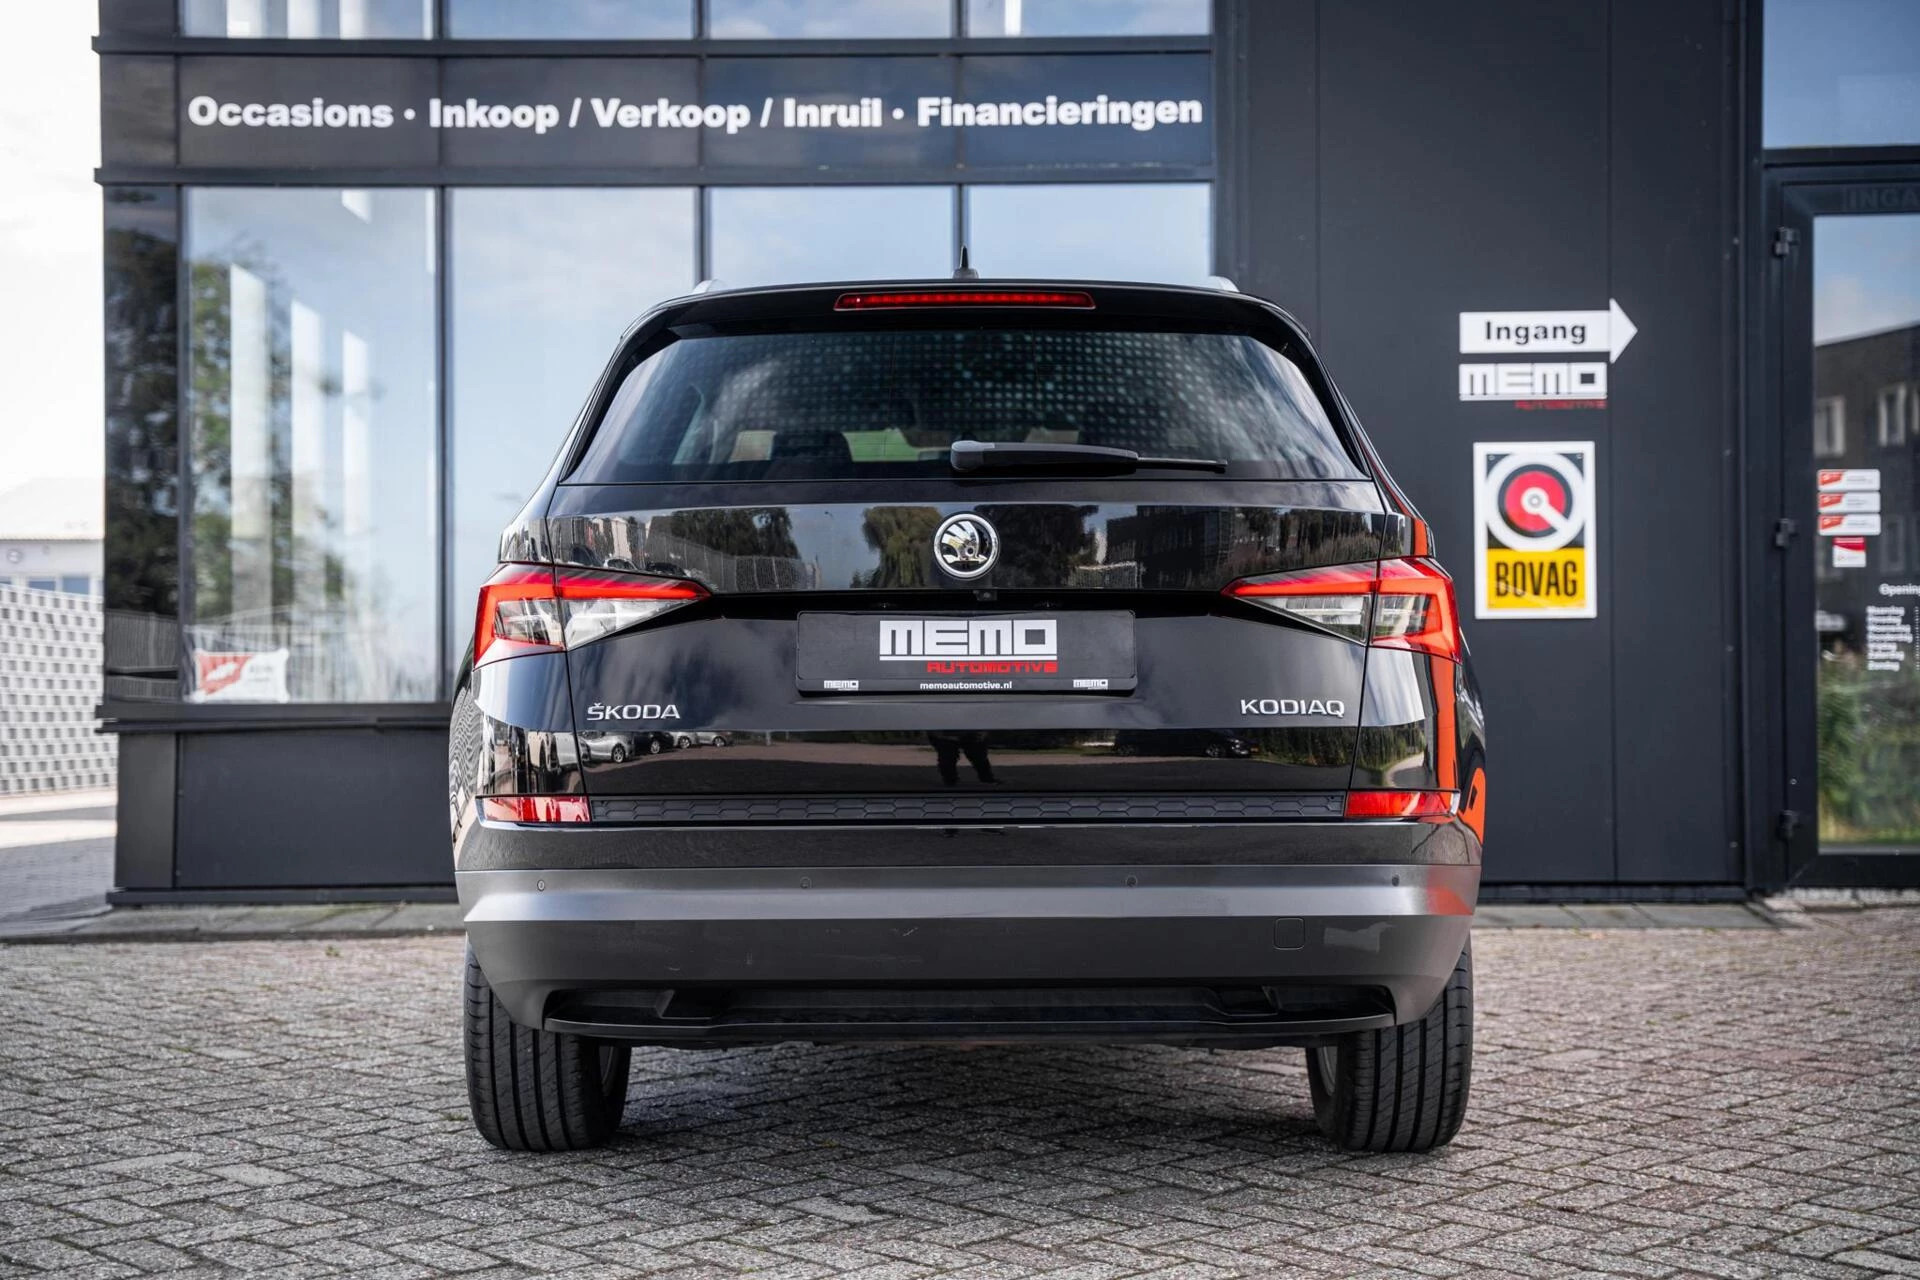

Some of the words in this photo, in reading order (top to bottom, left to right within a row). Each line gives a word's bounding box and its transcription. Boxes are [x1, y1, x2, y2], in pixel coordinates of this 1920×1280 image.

[188, 96, 394, 127] Occasions
[429, 98, 559, 134] Inkoop
[590, 98, 751, 134] Verkoop
[783, 97, 882, 127] Inruil
[917, 95, 1203, 131] Financieringen
[1486, 321, 1587, 344] Ingang
[1459, 362, 1607, 397] MEMO
[1495, 561, 1577, 597] BOVAG
[880, 620, 1057, 655] MEMO
[927, 661, 1058, 673] AUTOMOTIVE
[824, 680, 859, 689] MEMO
[920, 681, 1012, 690] memoautomotive.nl
[1073, 679, 1108, 688] MEMO
[587, 702, 680, 721] ŠKODA
[1240, 699, 1345, 718] KODIAQ
